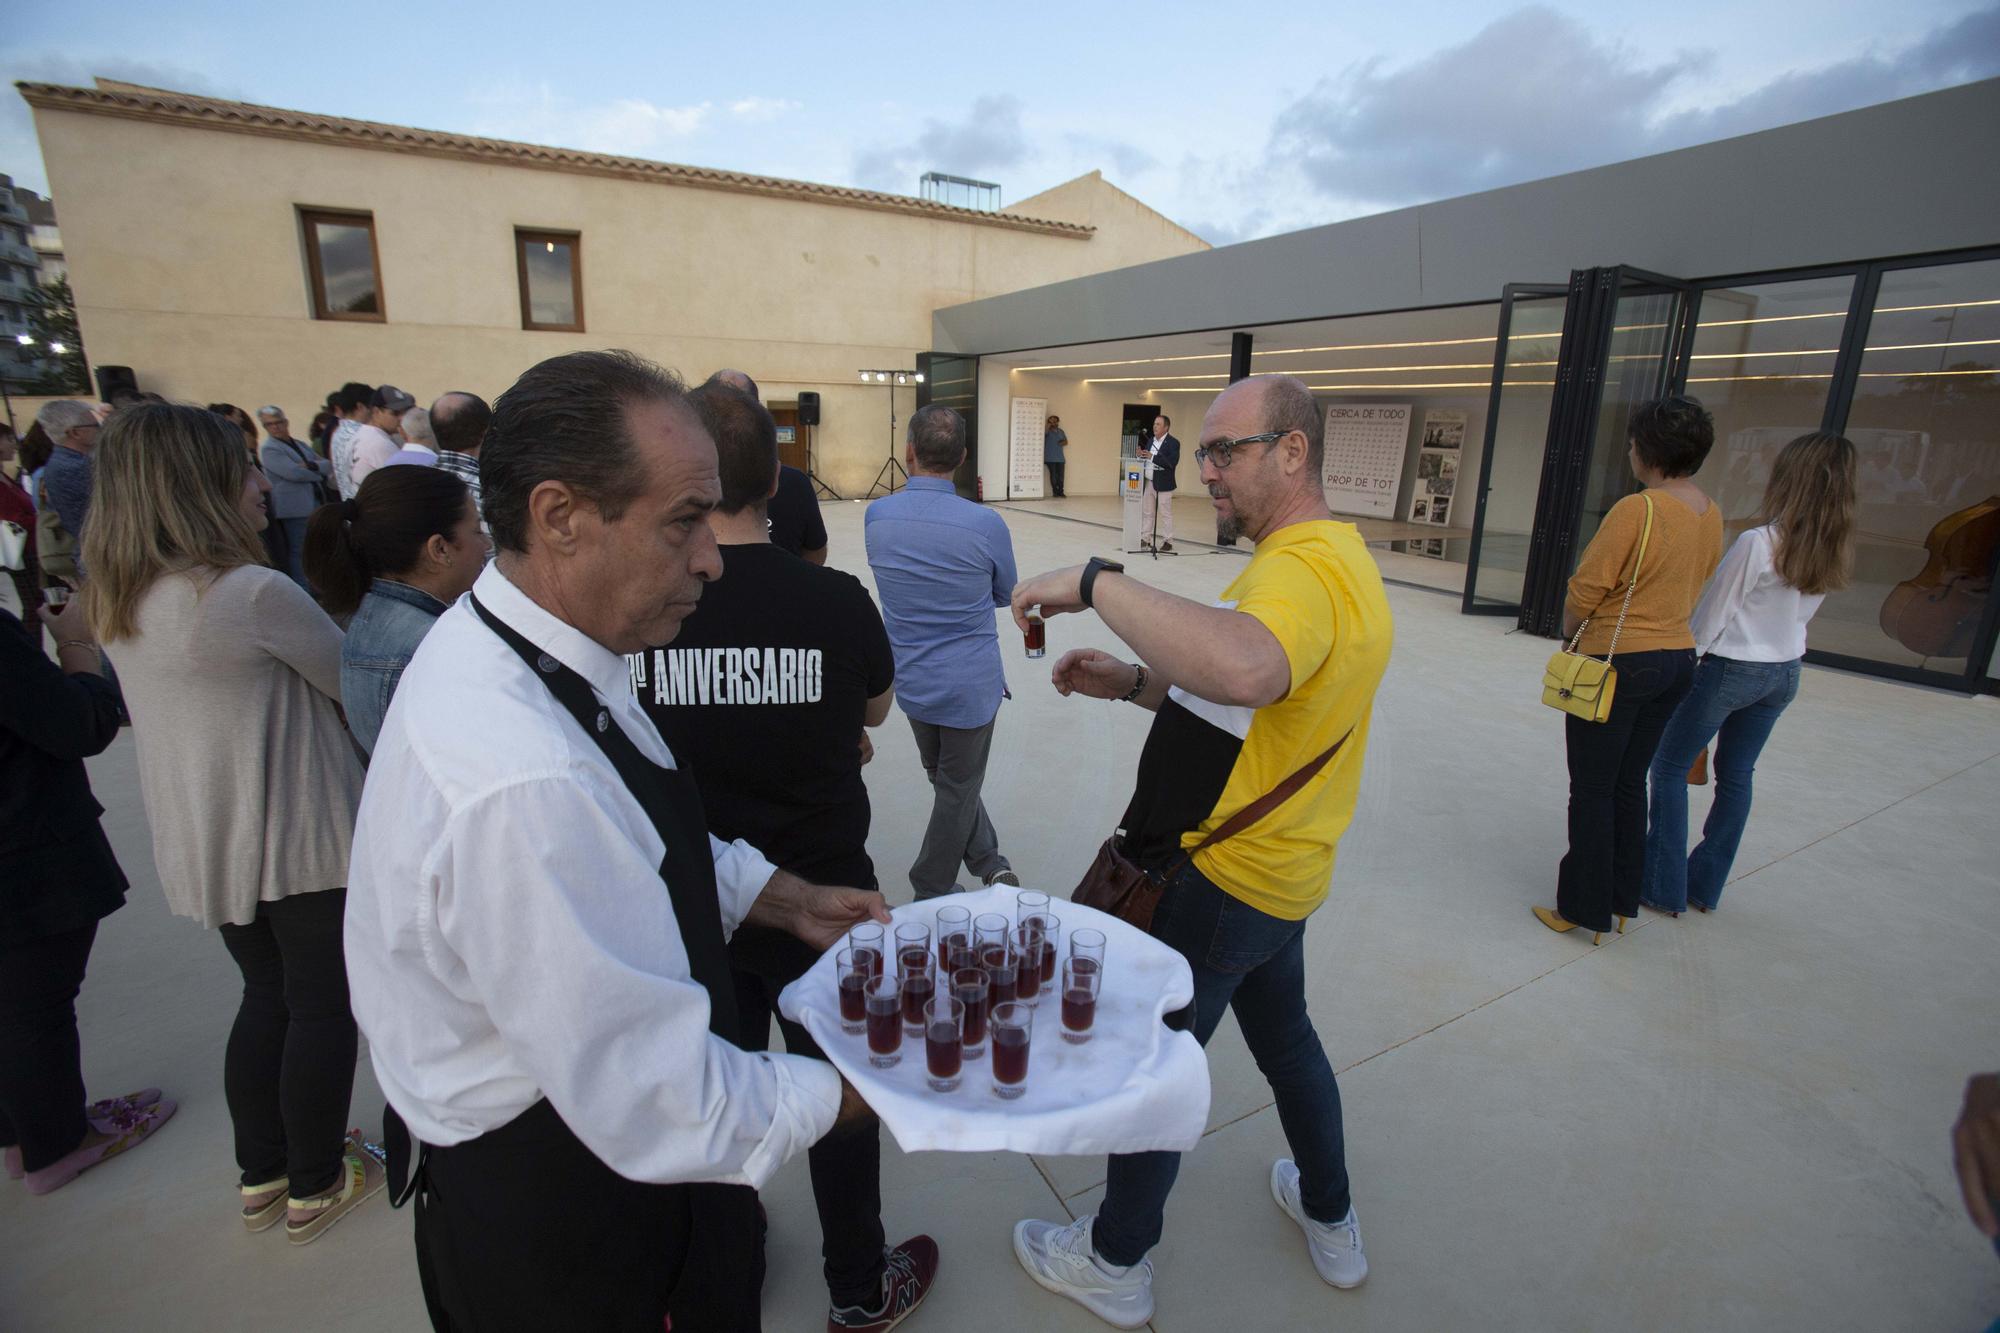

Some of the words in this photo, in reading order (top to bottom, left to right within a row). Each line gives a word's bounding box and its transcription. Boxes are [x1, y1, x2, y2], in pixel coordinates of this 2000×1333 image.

[1330, 408, 1360, 419] CERCA
[1362, 408, 1375, 419] DE
[1378, 408, 1406, 419] TODO
[1327, 474, 1352, 486] PROP
[1354, 477, 1368, 487] DE
[1373, 479, 1394, 489] TOT
[653, 647, 823, 705] ANIVERSARIO
